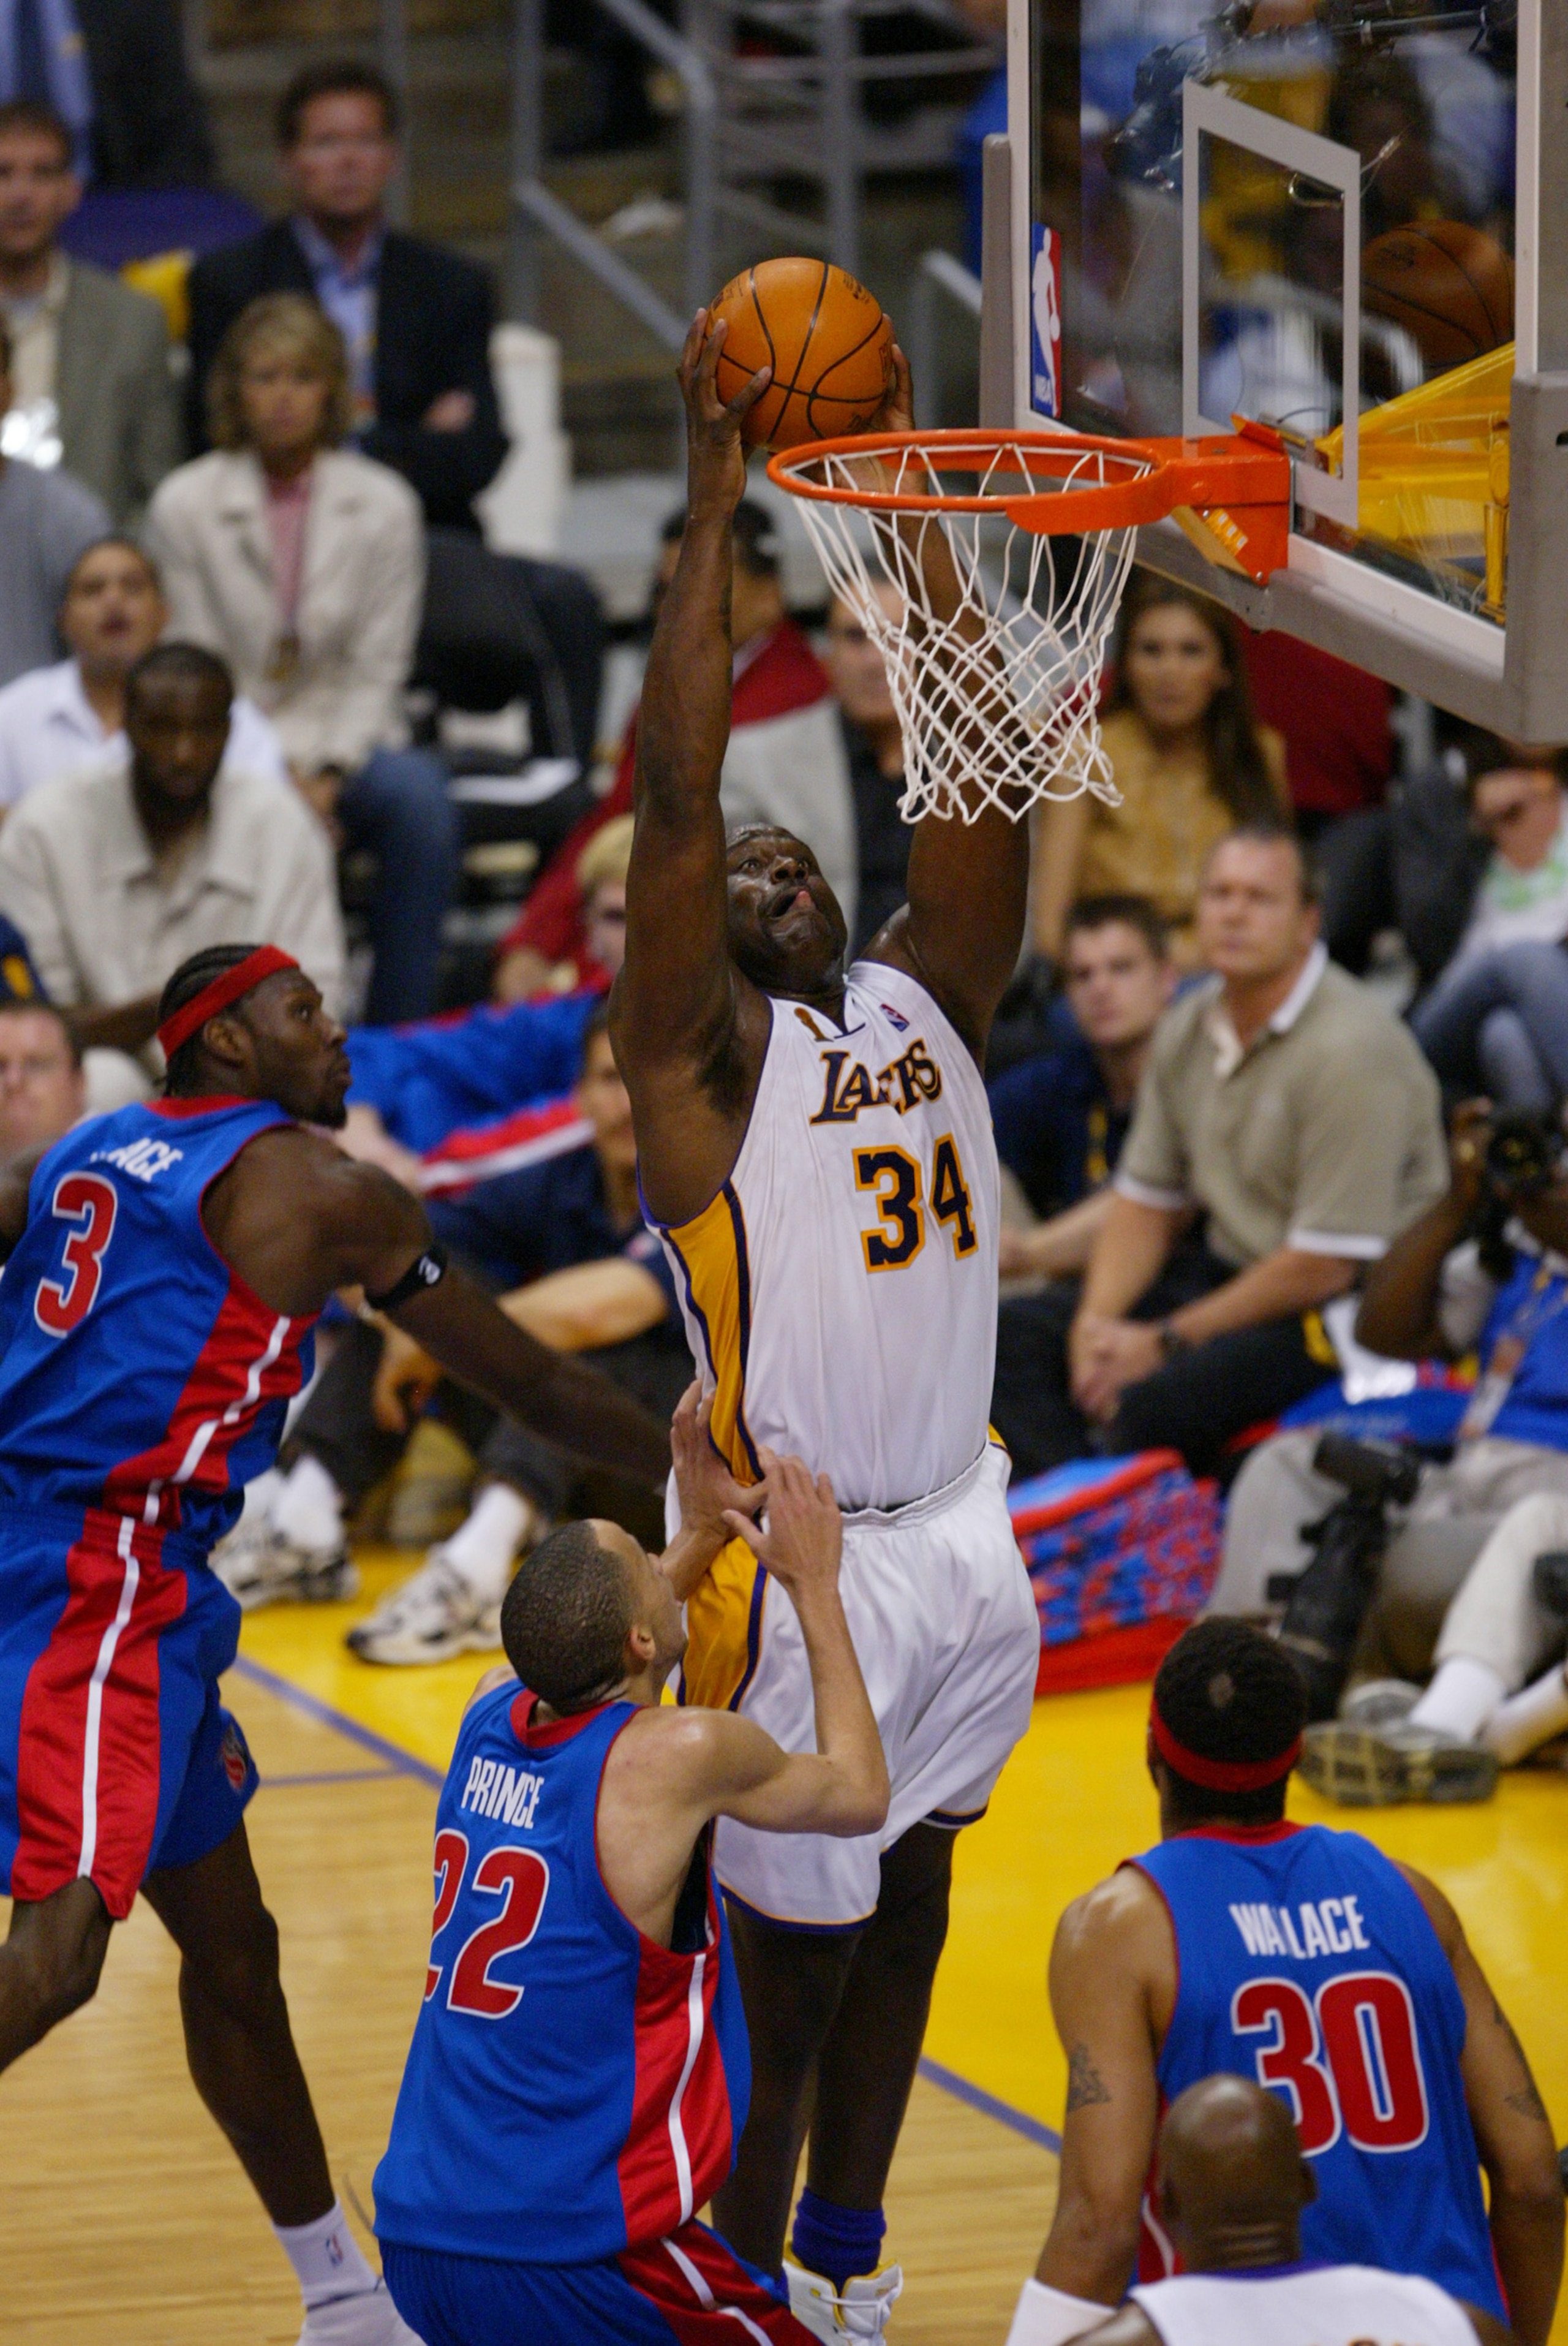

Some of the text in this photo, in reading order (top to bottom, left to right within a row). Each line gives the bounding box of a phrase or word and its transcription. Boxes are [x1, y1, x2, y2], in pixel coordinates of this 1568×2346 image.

[809, 1037, 942, 1126] LARS
[34, 1170, 118, 1339] 3
[851, 1132, 979, 1274] 34
[461, 1755, 545, 1830] PRINCE
[424, 1828, 550, 2020] 22
[1228, 1894, 1370, 1959] WALACE
[1231, 1970, 1429, 2157] 30
